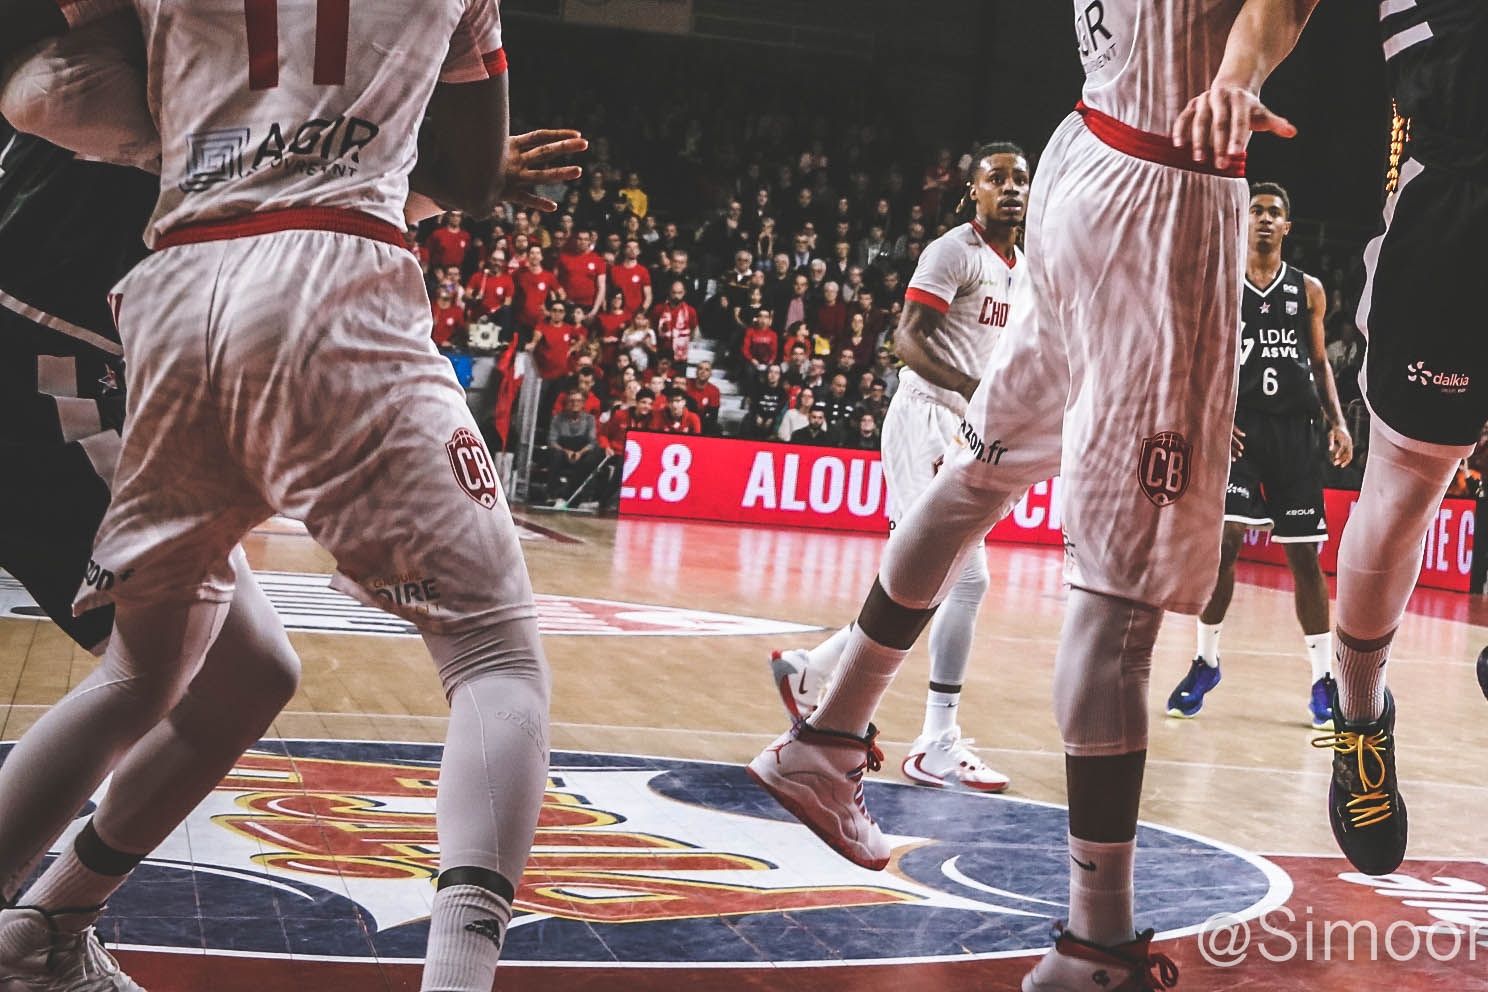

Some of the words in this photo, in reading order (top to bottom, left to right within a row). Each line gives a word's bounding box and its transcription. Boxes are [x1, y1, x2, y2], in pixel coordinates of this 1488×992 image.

[978, 295, 1011, 328] CHO
[1259, 328, 1298, 344] LDLC
[1262, 366, 1279, 396] 6
[1432, 372, 1470, 386] dalkia
[457, 445, 495, 490] CB
[1146, 447, 1184, 493] CB
[742, 452, 891, 519] ALOU
